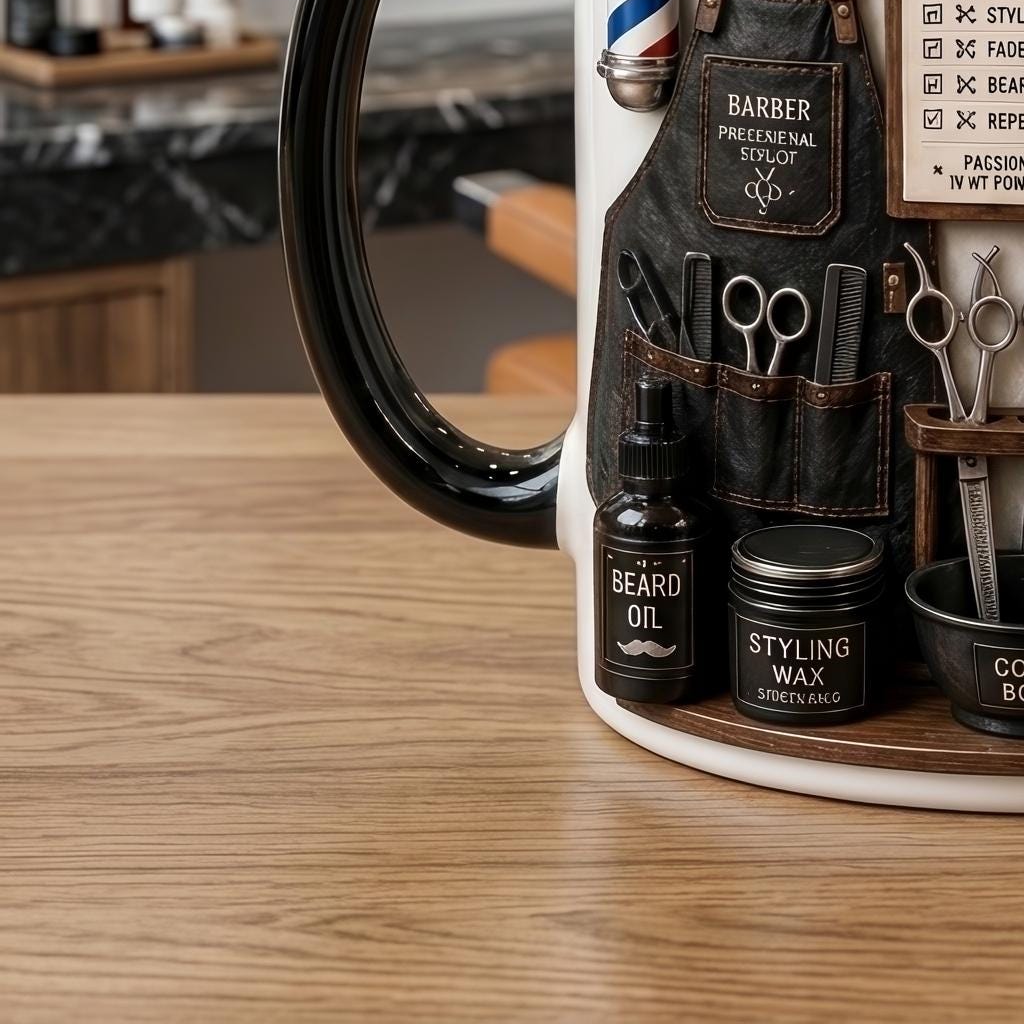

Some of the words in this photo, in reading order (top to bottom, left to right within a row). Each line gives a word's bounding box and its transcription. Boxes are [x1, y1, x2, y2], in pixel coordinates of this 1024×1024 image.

[728, 93, 811, 121] BARBER
[612, 568, 681, 598] BEARD
[627, 604, 663, 629] OIL
[749, 632, 849, 661] STYLING
[772, 664, 824, 686] WAX
